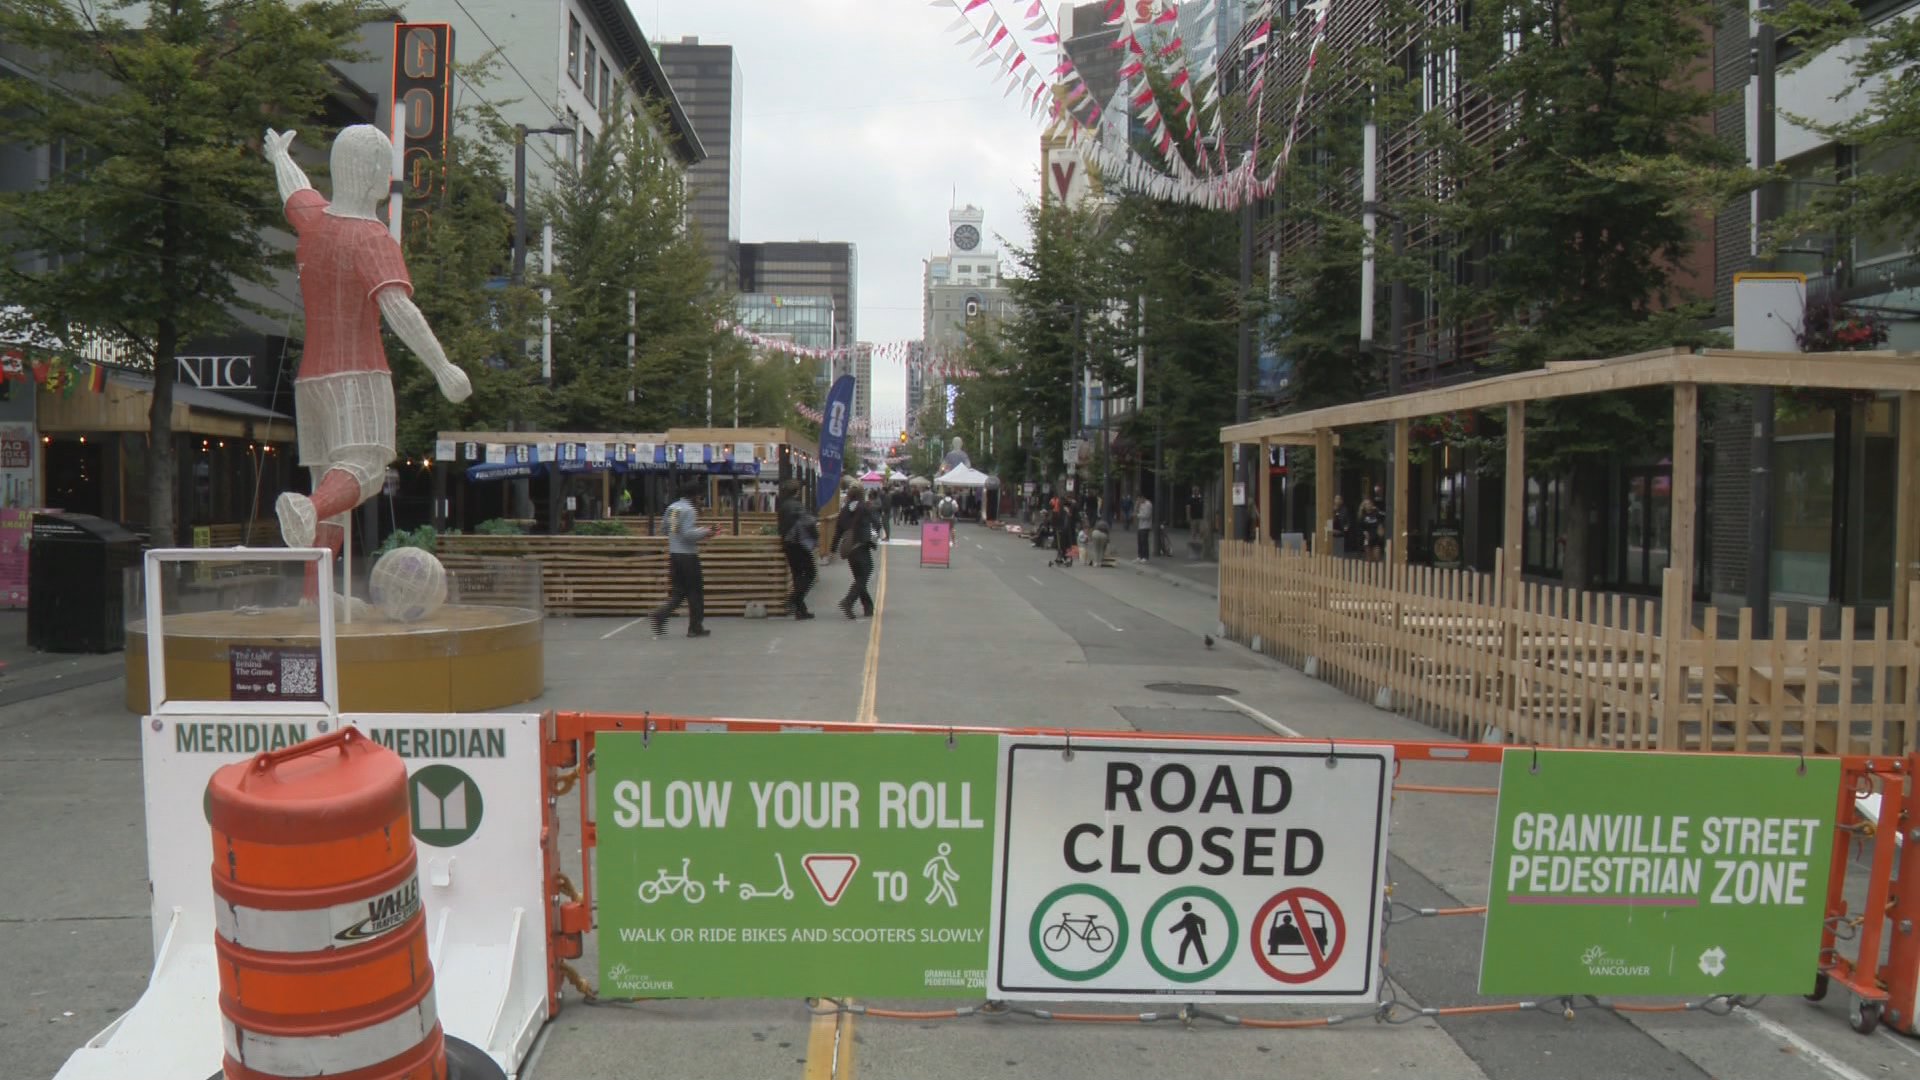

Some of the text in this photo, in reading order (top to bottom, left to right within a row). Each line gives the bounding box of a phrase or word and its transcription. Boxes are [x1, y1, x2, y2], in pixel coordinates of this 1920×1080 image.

[235, 660, 262, 668] Behind
[235, 668, 273, 676] The Game
[176, 723, 307, 753] MERIDIAN
[371, 728, 506, 758] MERIDIAN
[1104, 762, 1292, 815] ROAD
[613, 780, 984, 829] SLOW YOUR ROLL
[1512, 812, 1821, 856] GRANVILLE STREET
[1063, 823, 1325, 876] CLOSED
[872, 871, 908, 902] TO
[1507, 855, 1809, 905] PEDESTRIAN ZONE
[368, 877, 419, 922] VALLE
[619, 927, 984, 942] WALK OR RIDE BIKES AND SCOOTERS SLOWLY
[616, 981, 674, 990] VANCOUVER
[924, 969, 961, 978] GRANVILLE
[924, 977, 965, 986] PEDESTRIAN
[1589, 966, 1650, 976] VANCOUVER
